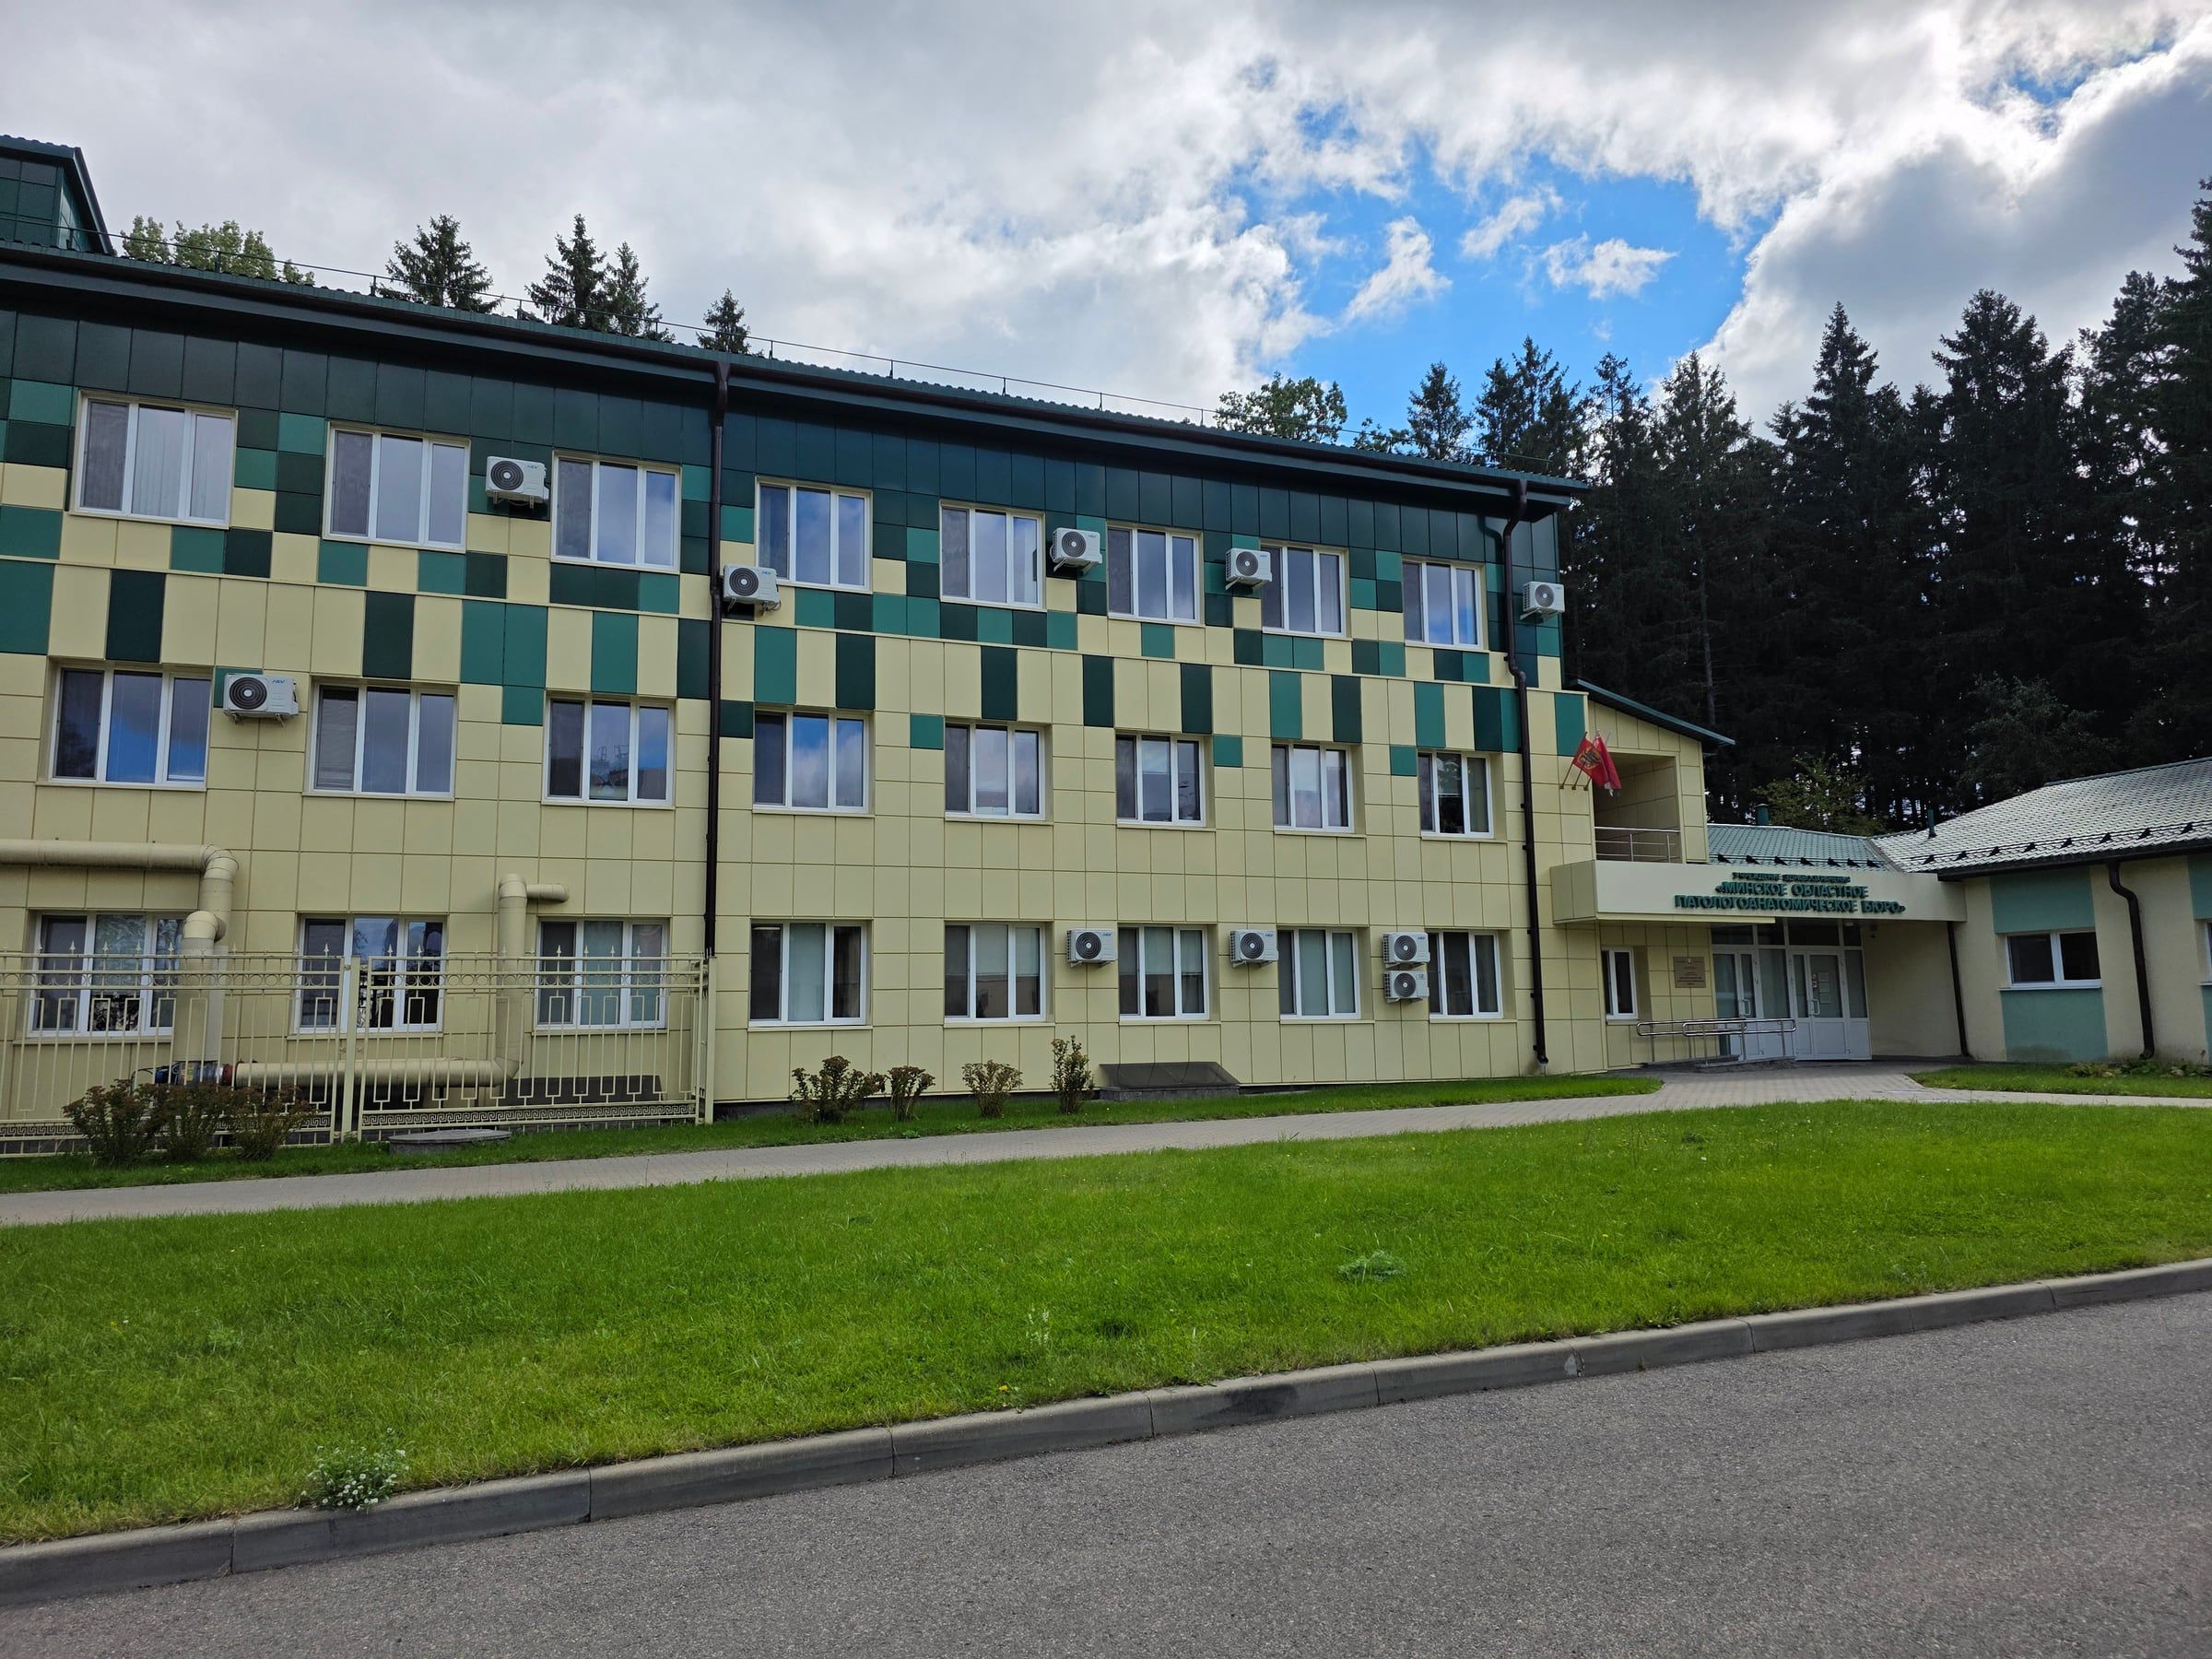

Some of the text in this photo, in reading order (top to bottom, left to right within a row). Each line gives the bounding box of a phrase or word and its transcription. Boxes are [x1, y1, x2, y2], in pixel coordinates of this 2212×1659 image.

[1715, 881, 1869, 899] «МИНСКОЕ ОБЛАСТНОЕ
[1675, 895, 1858, 913] ПАТОЛОГОАНАТОМИЧЕСКОЕ
